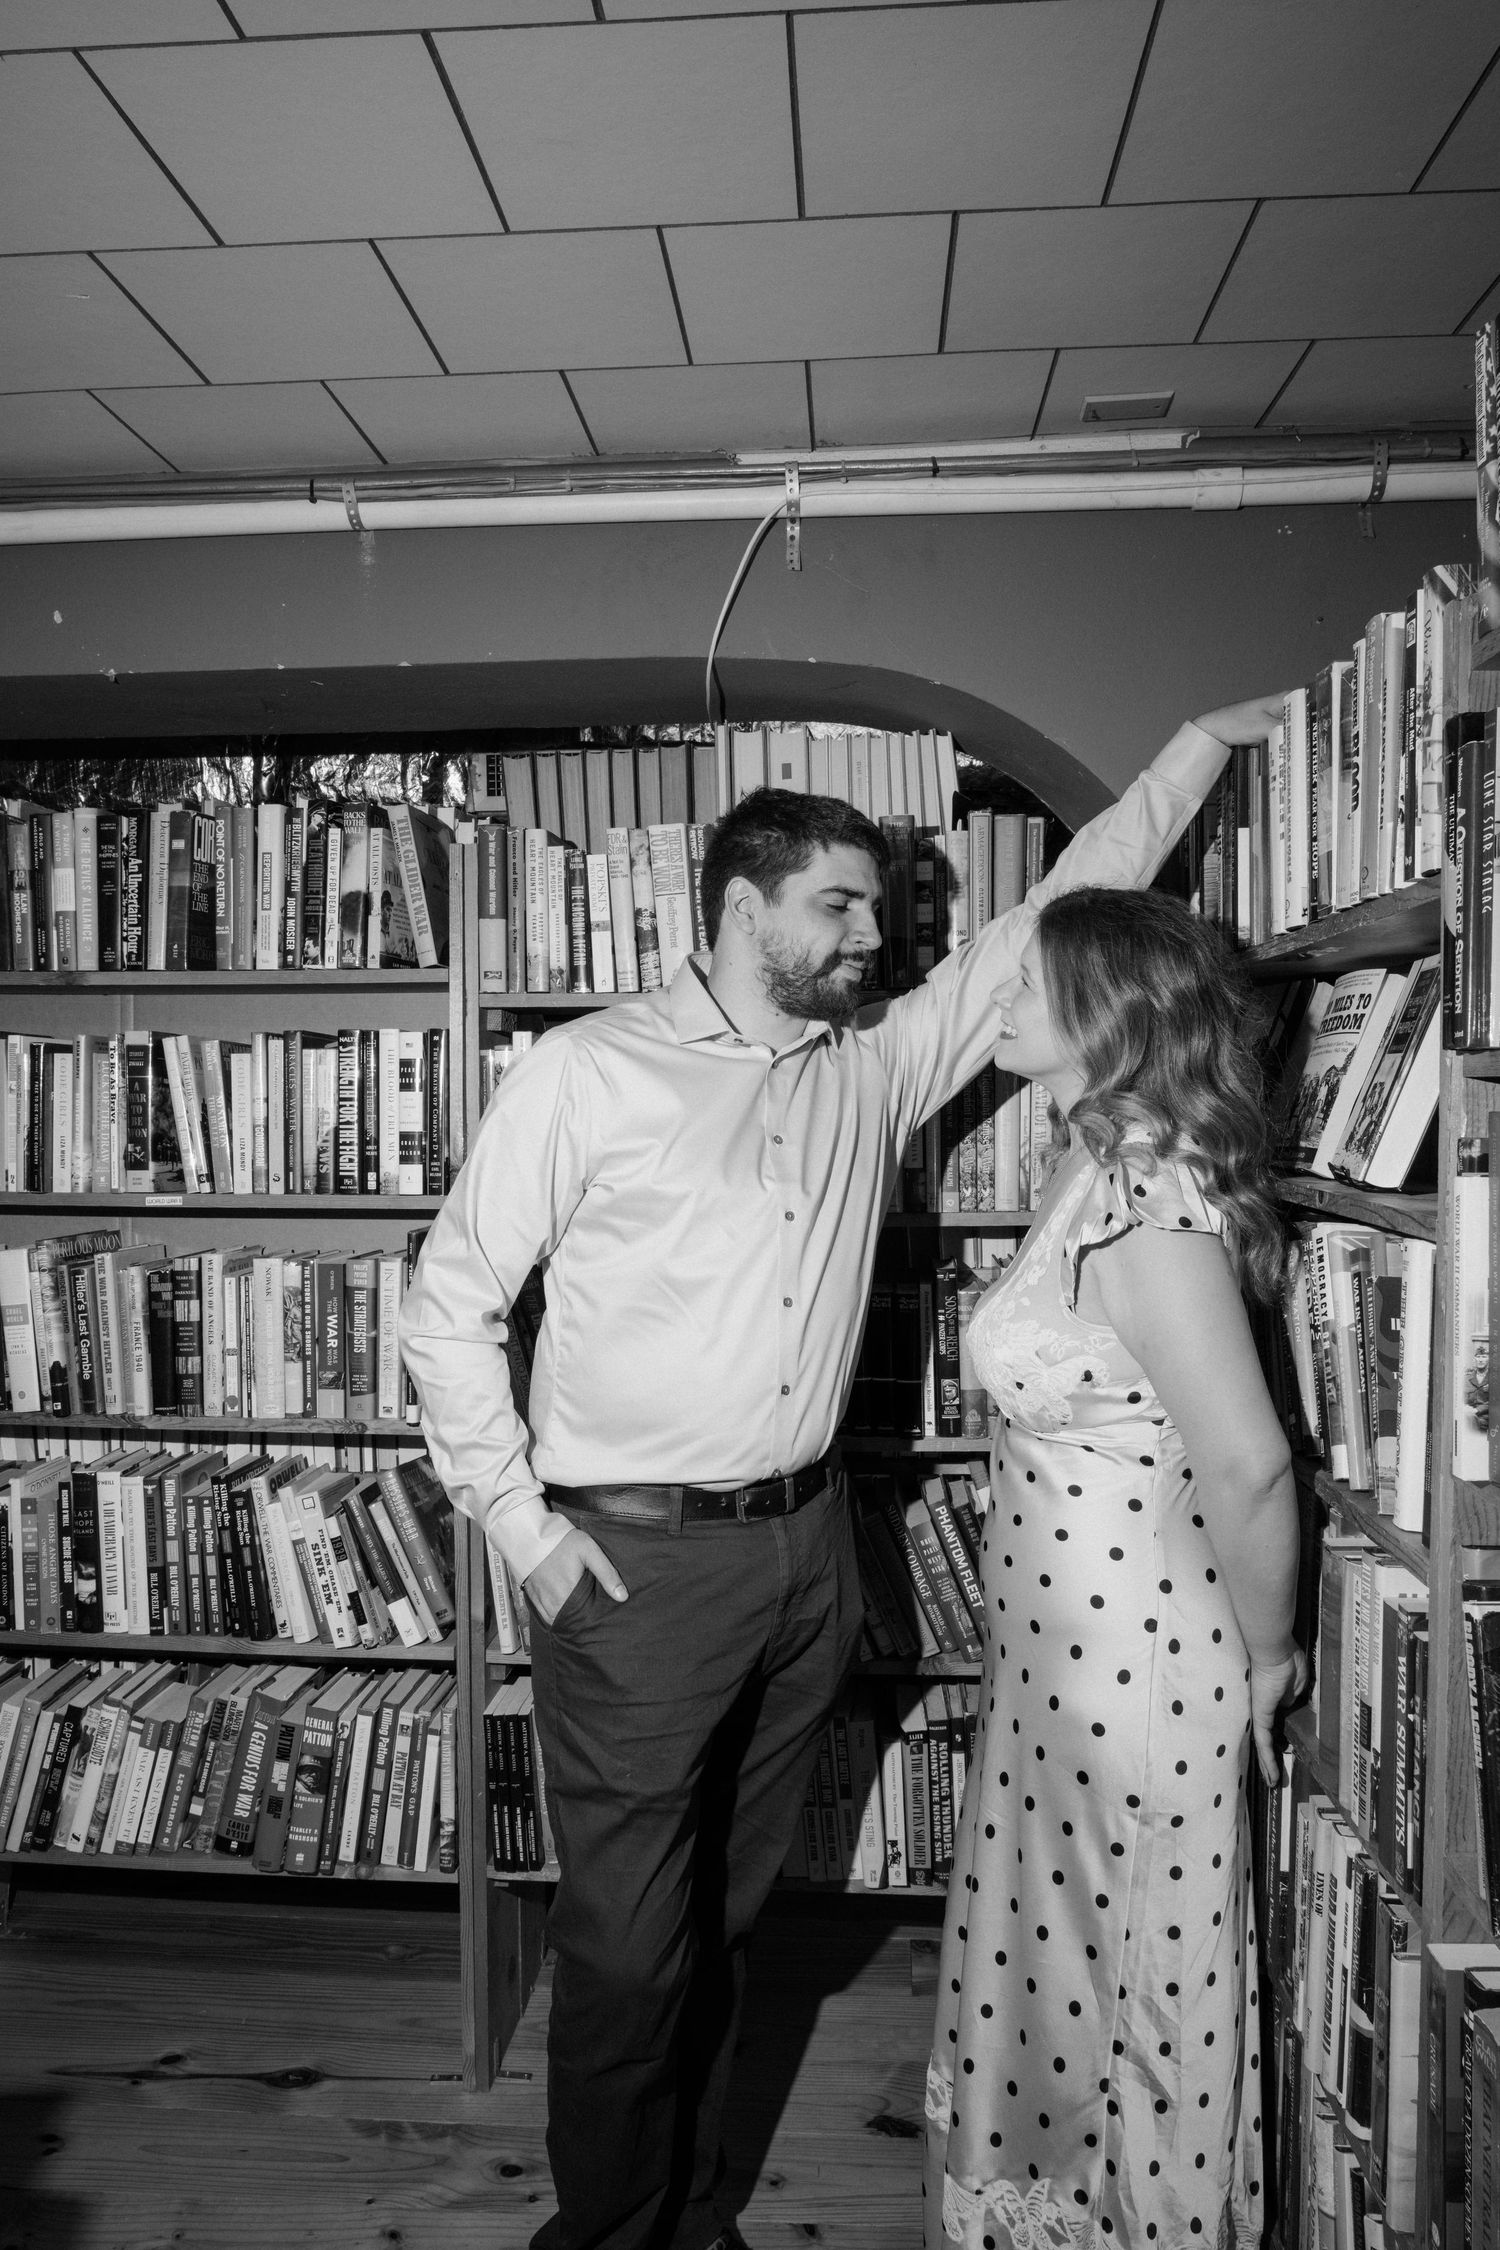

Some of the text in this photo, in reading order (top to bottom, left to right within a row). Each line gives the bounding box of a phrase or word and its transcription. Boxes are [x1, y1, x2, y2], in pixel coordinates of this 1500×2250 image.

[80, 837, 91, 855] THE
[157, 820, 170, 905] Deterrent Diplomacy
[330, 839, 338, 862] GIVEN
[651, 832, 670, 893] TO BE WON
[1482, 770, 1494, 914] LONE STAR STALAG
[128, 817, 142, 953] MORGAN An Uncertain Hour
[216, 819, 225, 917] POINT OF NO RETURN
[263, 854, 271, 891] REPORTING
[308, 839, 324, 894] DEATHRIDE
[330, 866, 337, 875] UP
[396, 816, 429, 936] THE GLIDER WAR
[597, 862, 607, 913] POPSKI'S
[14, 893, 22, 944] MOOREHEAD
[81, 897, 93, 941] ALLIANCE
[286, 897, 296, 950] JOHN MOSIER
[572, 886, 587, 966] THE LACONIA AFFAIR
[666, 897, 678, 948] Geoffrey Perret
[1455, 808, 1466, 1014] A QUESTION OF SEDITION
[1358, 994, 1372, 1008] TO
[110, 1046, 116, 1059] To
[110, 1062, 116, 1077] Be
[110, 1080, 116, 1090] As
[433, 1097, 438, 1106] OF
[340, 1046, 357, 1176] STRENGTH FOR THE FIGHT
[97, 1257, 105, 1274] THE
[103, 1341, 111, 1374] HITLER
[355, 1290, 366, 1303] THE
[1355, 1307, 1360, 1320] IN
[75, 1274, 91, 1380] Hitler's Last Gamble
[134, 1322, 142, 1350] FRANCE
[327, 1314, 337, 1348] WAR
[354, 1306, 367, 1353] STRATEGISTS
[384, 1268, 393, 1371] IN TIME OF WAR
[945, 1296, 958, 1361] SONS REICH
[48, 1512, 56, 1544] THOSE
[164, 1480, 177, 1536] Killing Patton
[187, 1506, 197, 1551] Killing Patton
[103, 1509, 117, 1561] DEMOCRACY
[885, 1505, 932, 1599] SUDDEN COURAGE
[935, 1506, 983, 1607] PHANTOM FLEET
[106, 1563, 117, 1573] AT
[106, 1575, 118, 1596] WAR
[311, 1543, 333, 1605] SINK 'EM
[50, 1581, 58, 1604] DAYS
[150, 1573, 160, 1619] BILL O'REILLY
[55, 1722, 73, 1762] CAPTURED
[89, 1717, 113, 1766] SCHNELLBOOTE
[209, 1701, 228, 1741] PATTON
[222, 1701, 237, 1741] BLUMENSON
[231, 1710, 243, 1737] MARTIN
[276, 1724, 294, 1761] PATTON
[303, 1731, 331, 1747] PATTON
[306, 1717, 333, 1731] GENERAL
[377, 1708, 393, 1764] Killing Patton
[233, 1721, 268, 1817] A GENIUS FOR WAR
[930, 1739, 938, 1780] AGAINST
[1395, 1656, 1406, 1846] WAR SUMMITS
[408, 1760, 420, 1816] PATTON'S GAP
[931, 1784, 939, 1802] THE
[939, 1743, 952, 1858] ROLLING THUNDER
[226, 1828, 248, 1840] D'ESTE
[228, 1820, 250, 1832] CARLO
[368, 1794, 381, 1835] BILL O'REILLY
[911, 1758, 925, 1865] THE FORGOTTEN SOLDIER
[1315, 1903, 1323, 1917] OF
